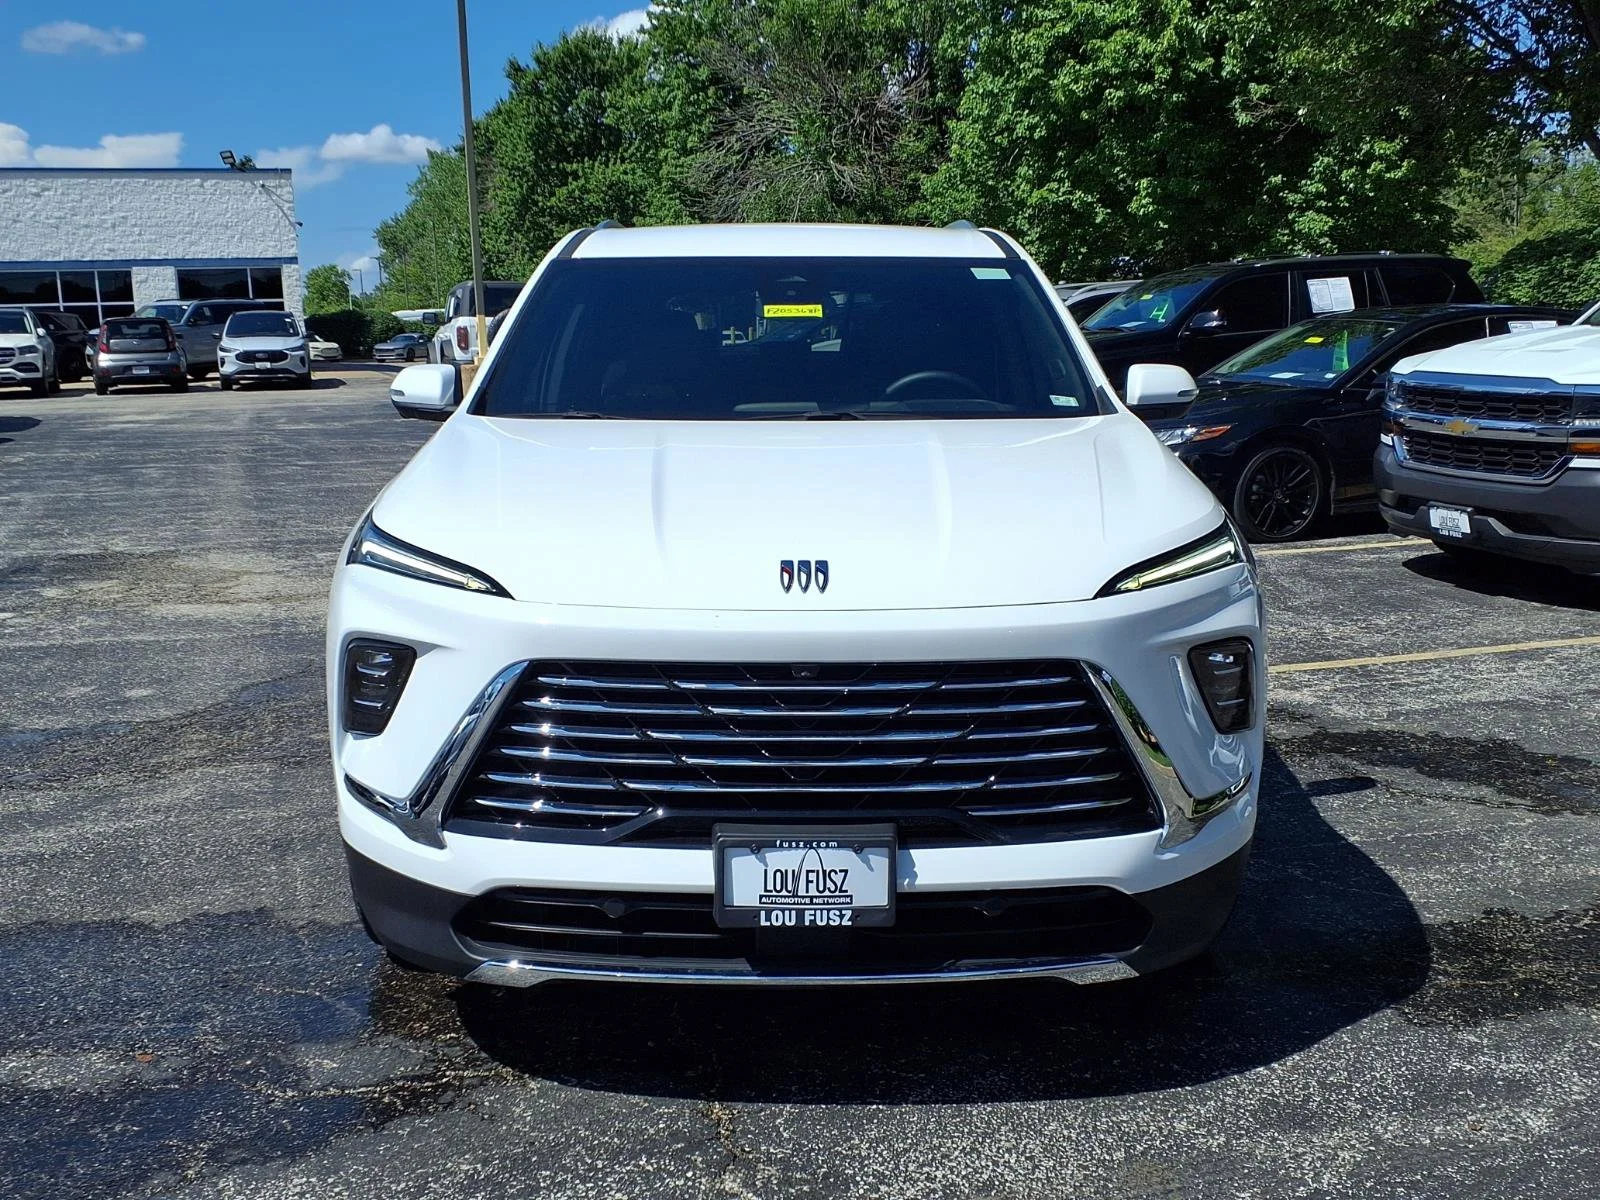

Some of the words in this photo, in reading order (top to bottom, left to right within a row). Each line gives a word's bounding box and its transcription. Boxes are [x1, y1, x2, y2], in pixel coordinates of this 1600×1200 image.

[775, 839, 839, 848] fusz.com
[763, 868, 796, 894] LOU
[804, 868, 849, 894] FUSZ
[760, 896, 811, 905] AUTOMOTIVE
[812, 896, 852, 905] NETWORK
[759, 909, 797, 926] LOU
[804, 909, 853, 926] FUSZ
